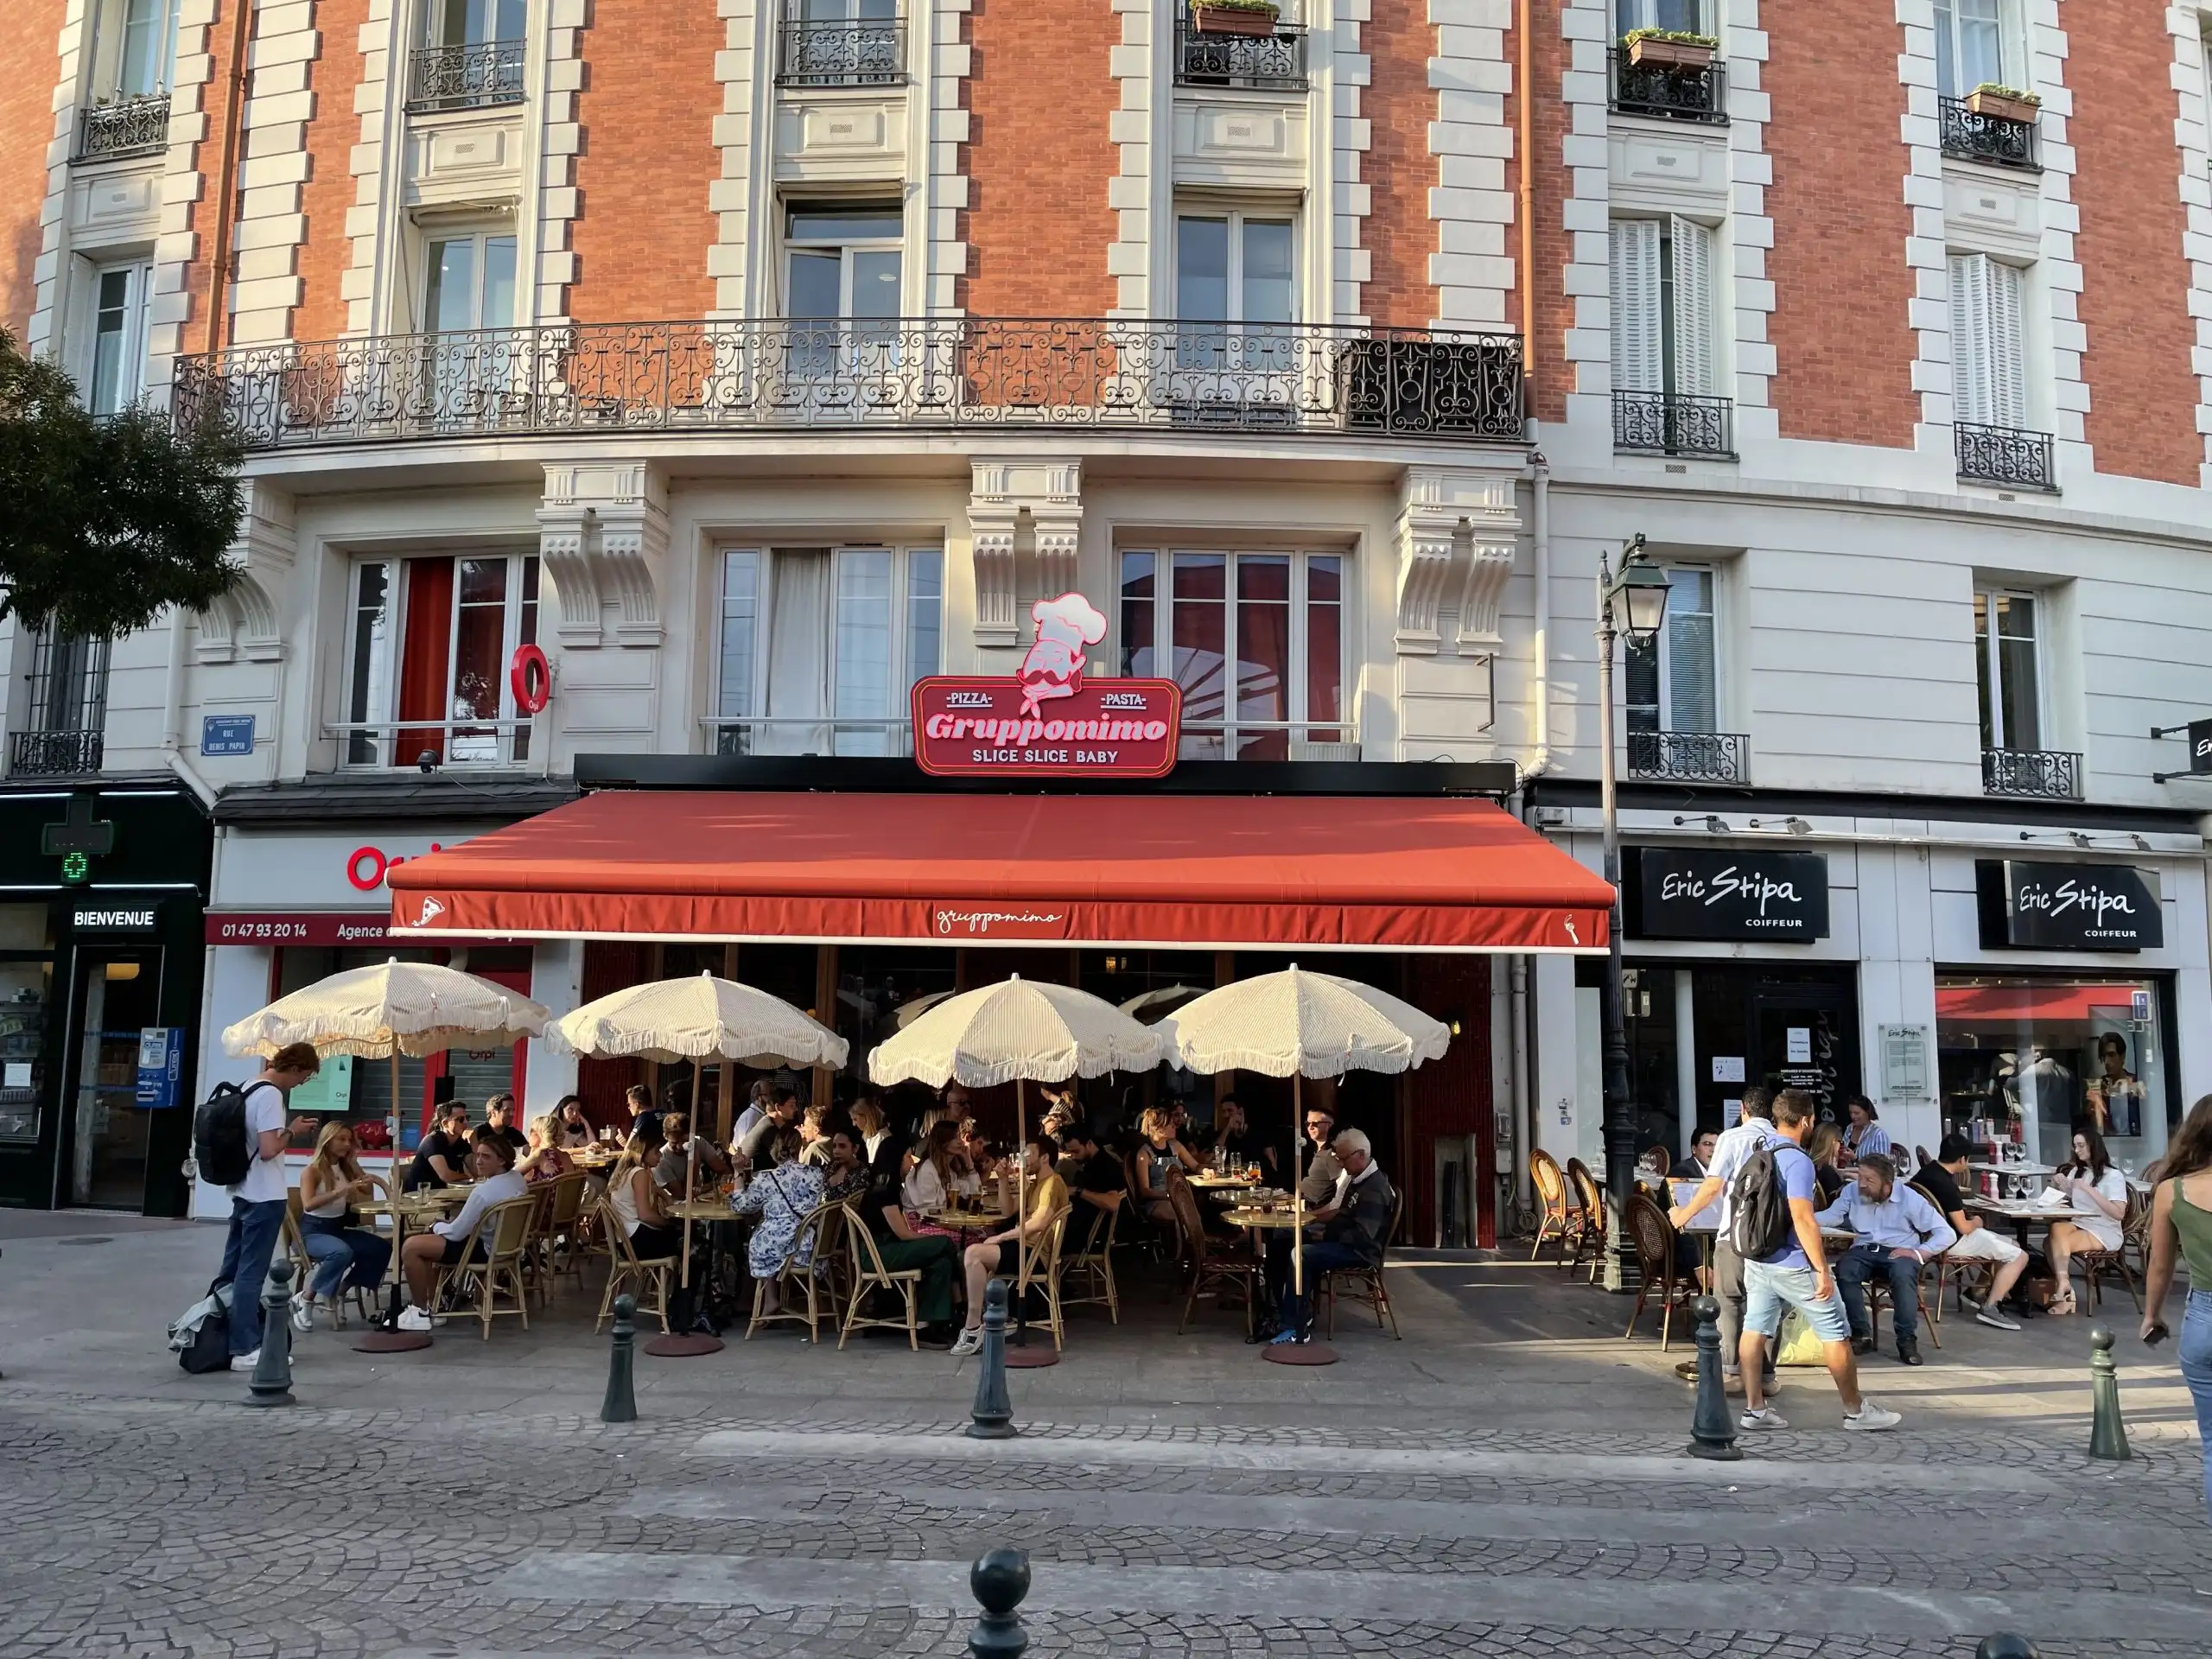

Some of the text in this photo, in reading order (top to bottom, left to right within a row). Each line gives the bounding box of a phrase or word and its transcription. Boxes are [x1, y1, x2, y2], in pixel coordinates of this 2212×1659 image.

[223, 729, 234, 738] RUE
[925, 711, 1168, 747] Gruppomimo
[972, 749, 1118, 764] SLICE SLICE BABY
[1661, 866, 1802, 917] Eric Stipa
[2019, 879, 2136, 928] Eric Stipa
[73, 911, 155, 926] BIENVENUE
[937, 910, 1063, 934] gruppomimo
[1745, 918, 1803, 927] COIFFEUR
[222, 924, 308, 938] 01 47 93 20 14
[337, 923, 383, 940] Agence
